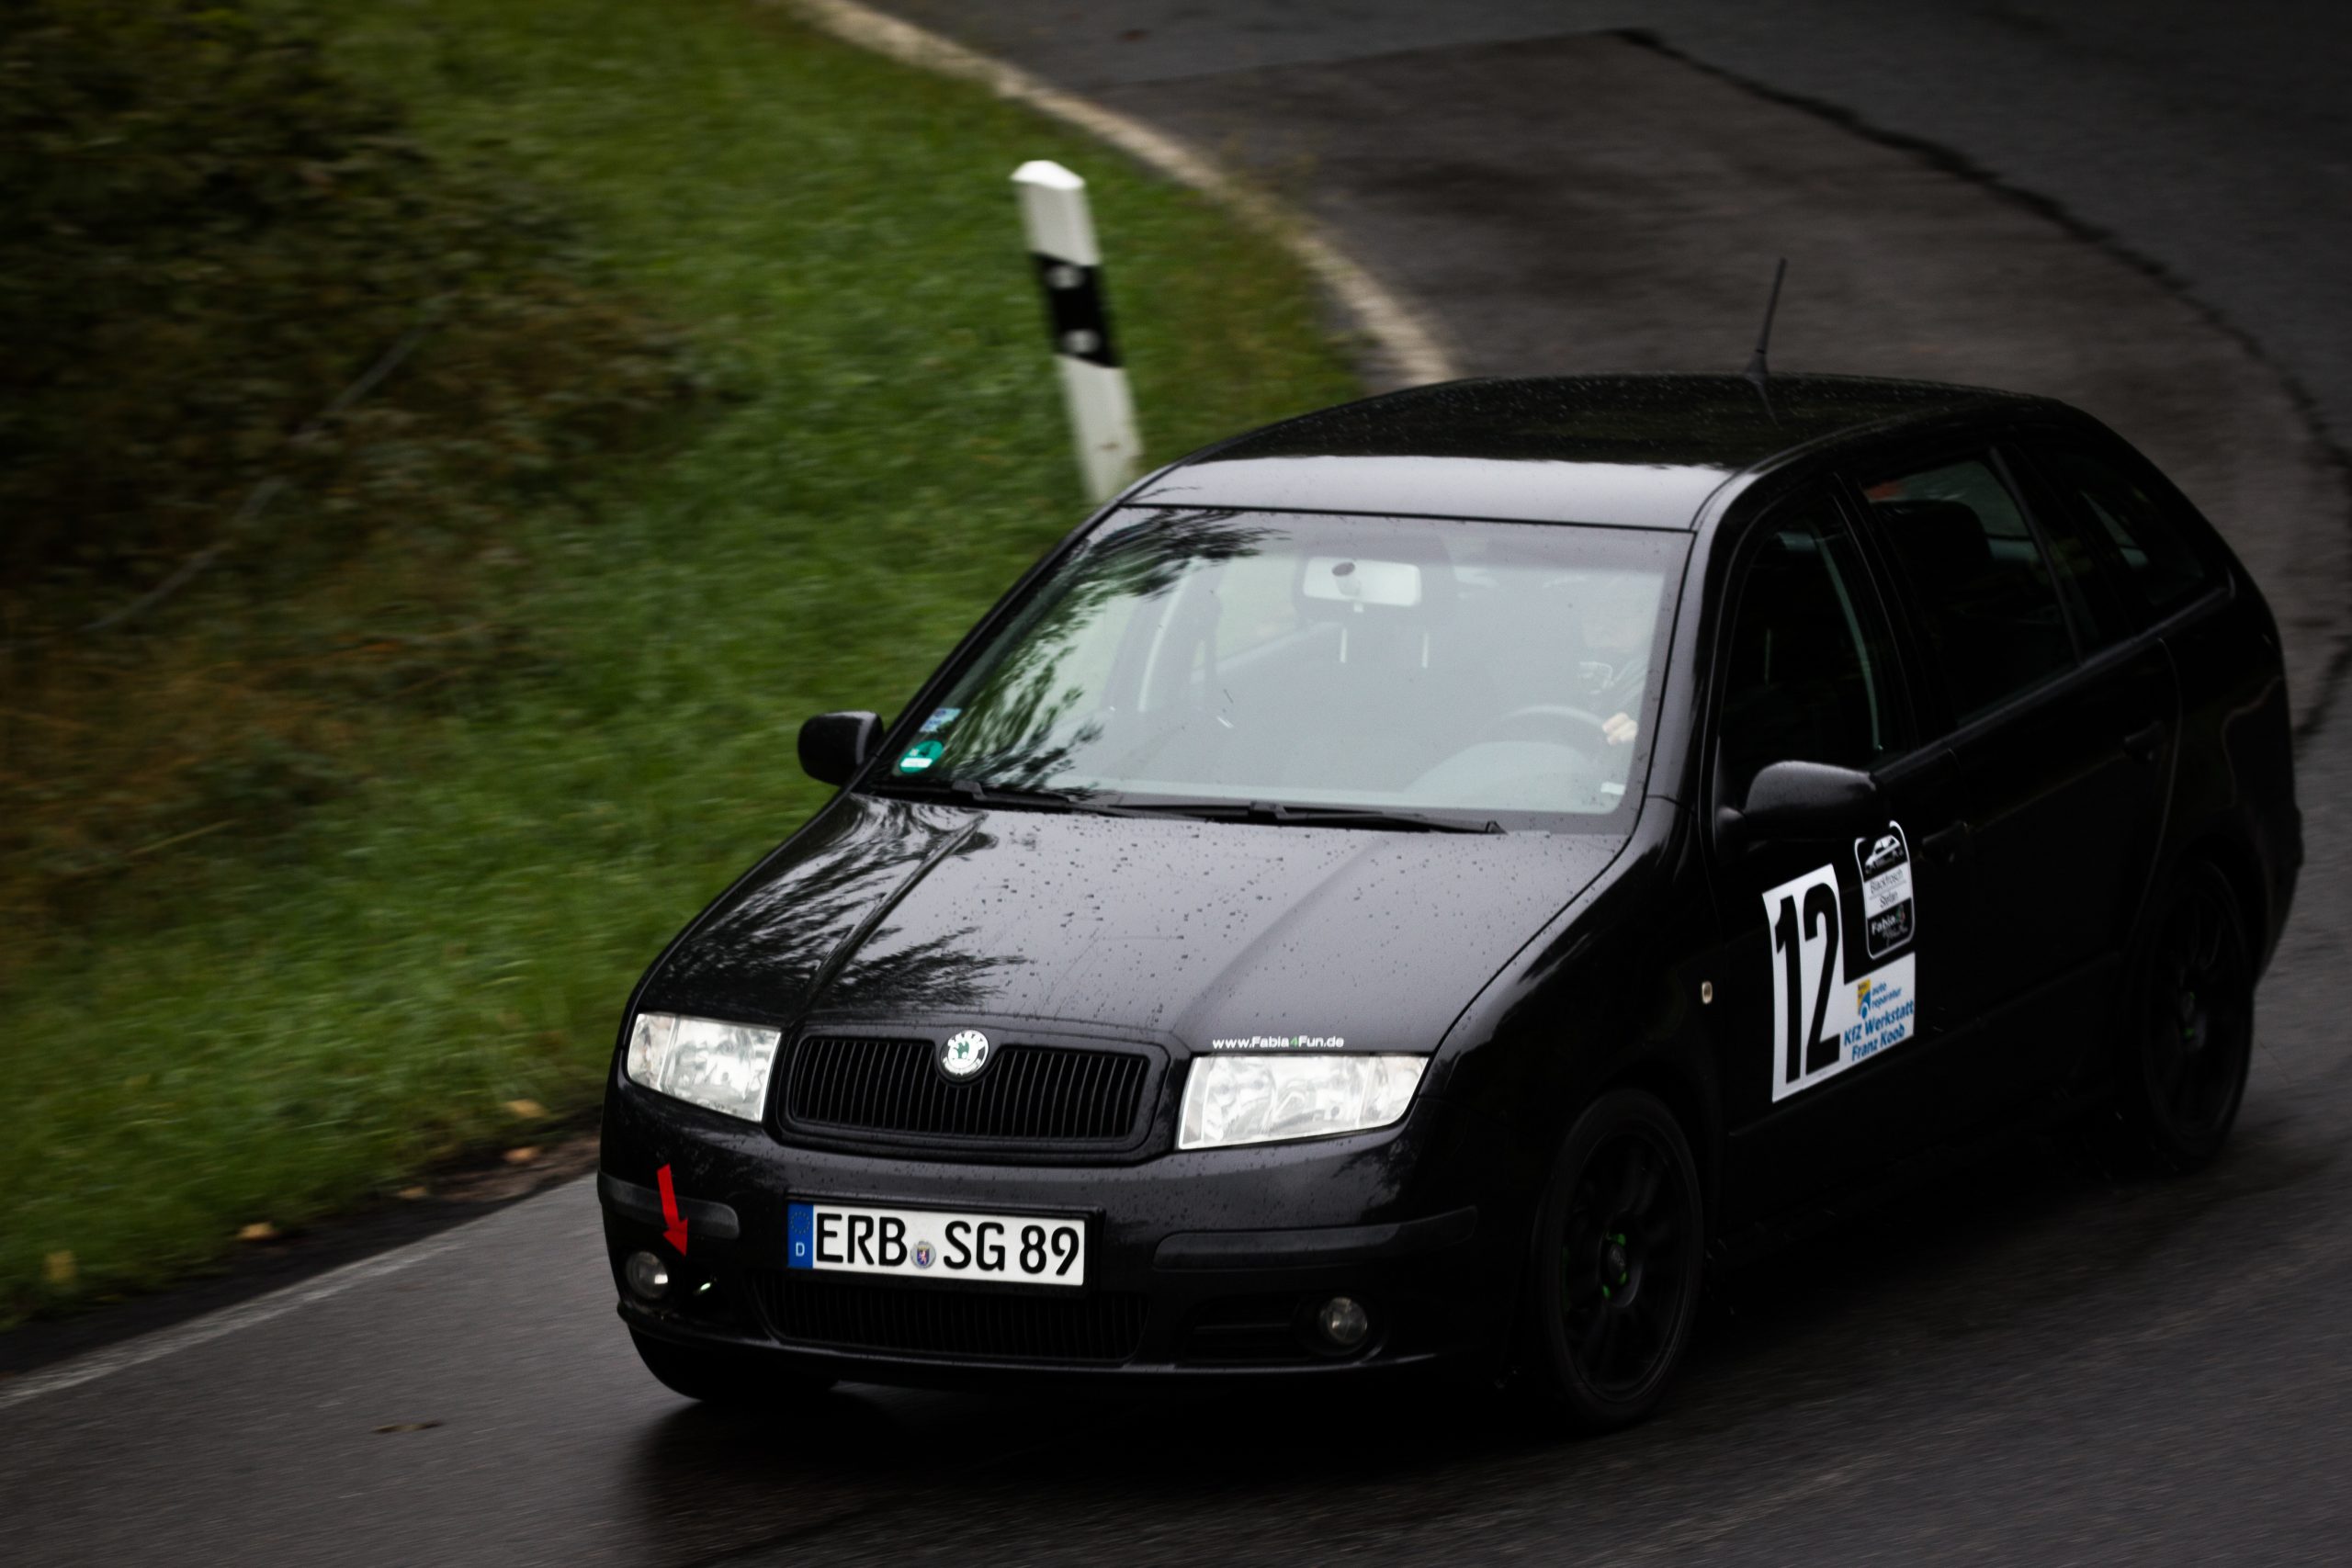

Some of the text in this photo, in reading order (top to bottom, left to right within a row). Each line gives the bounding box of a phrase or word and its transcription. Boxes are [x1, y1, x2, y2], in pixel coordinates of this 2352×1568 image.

[1775, 882, 1840, 1085] 12
[1864, 999, 1914, 1036] Werkstatt
[1212, 1035, 1345, 1049] www.Fabia4Fun.de
[1852, 1023, 1905, 1061] Franz Koob
[796, 1242, 805, 1257] D
[816, 1213, 1080, 1276] ERB SG 89
